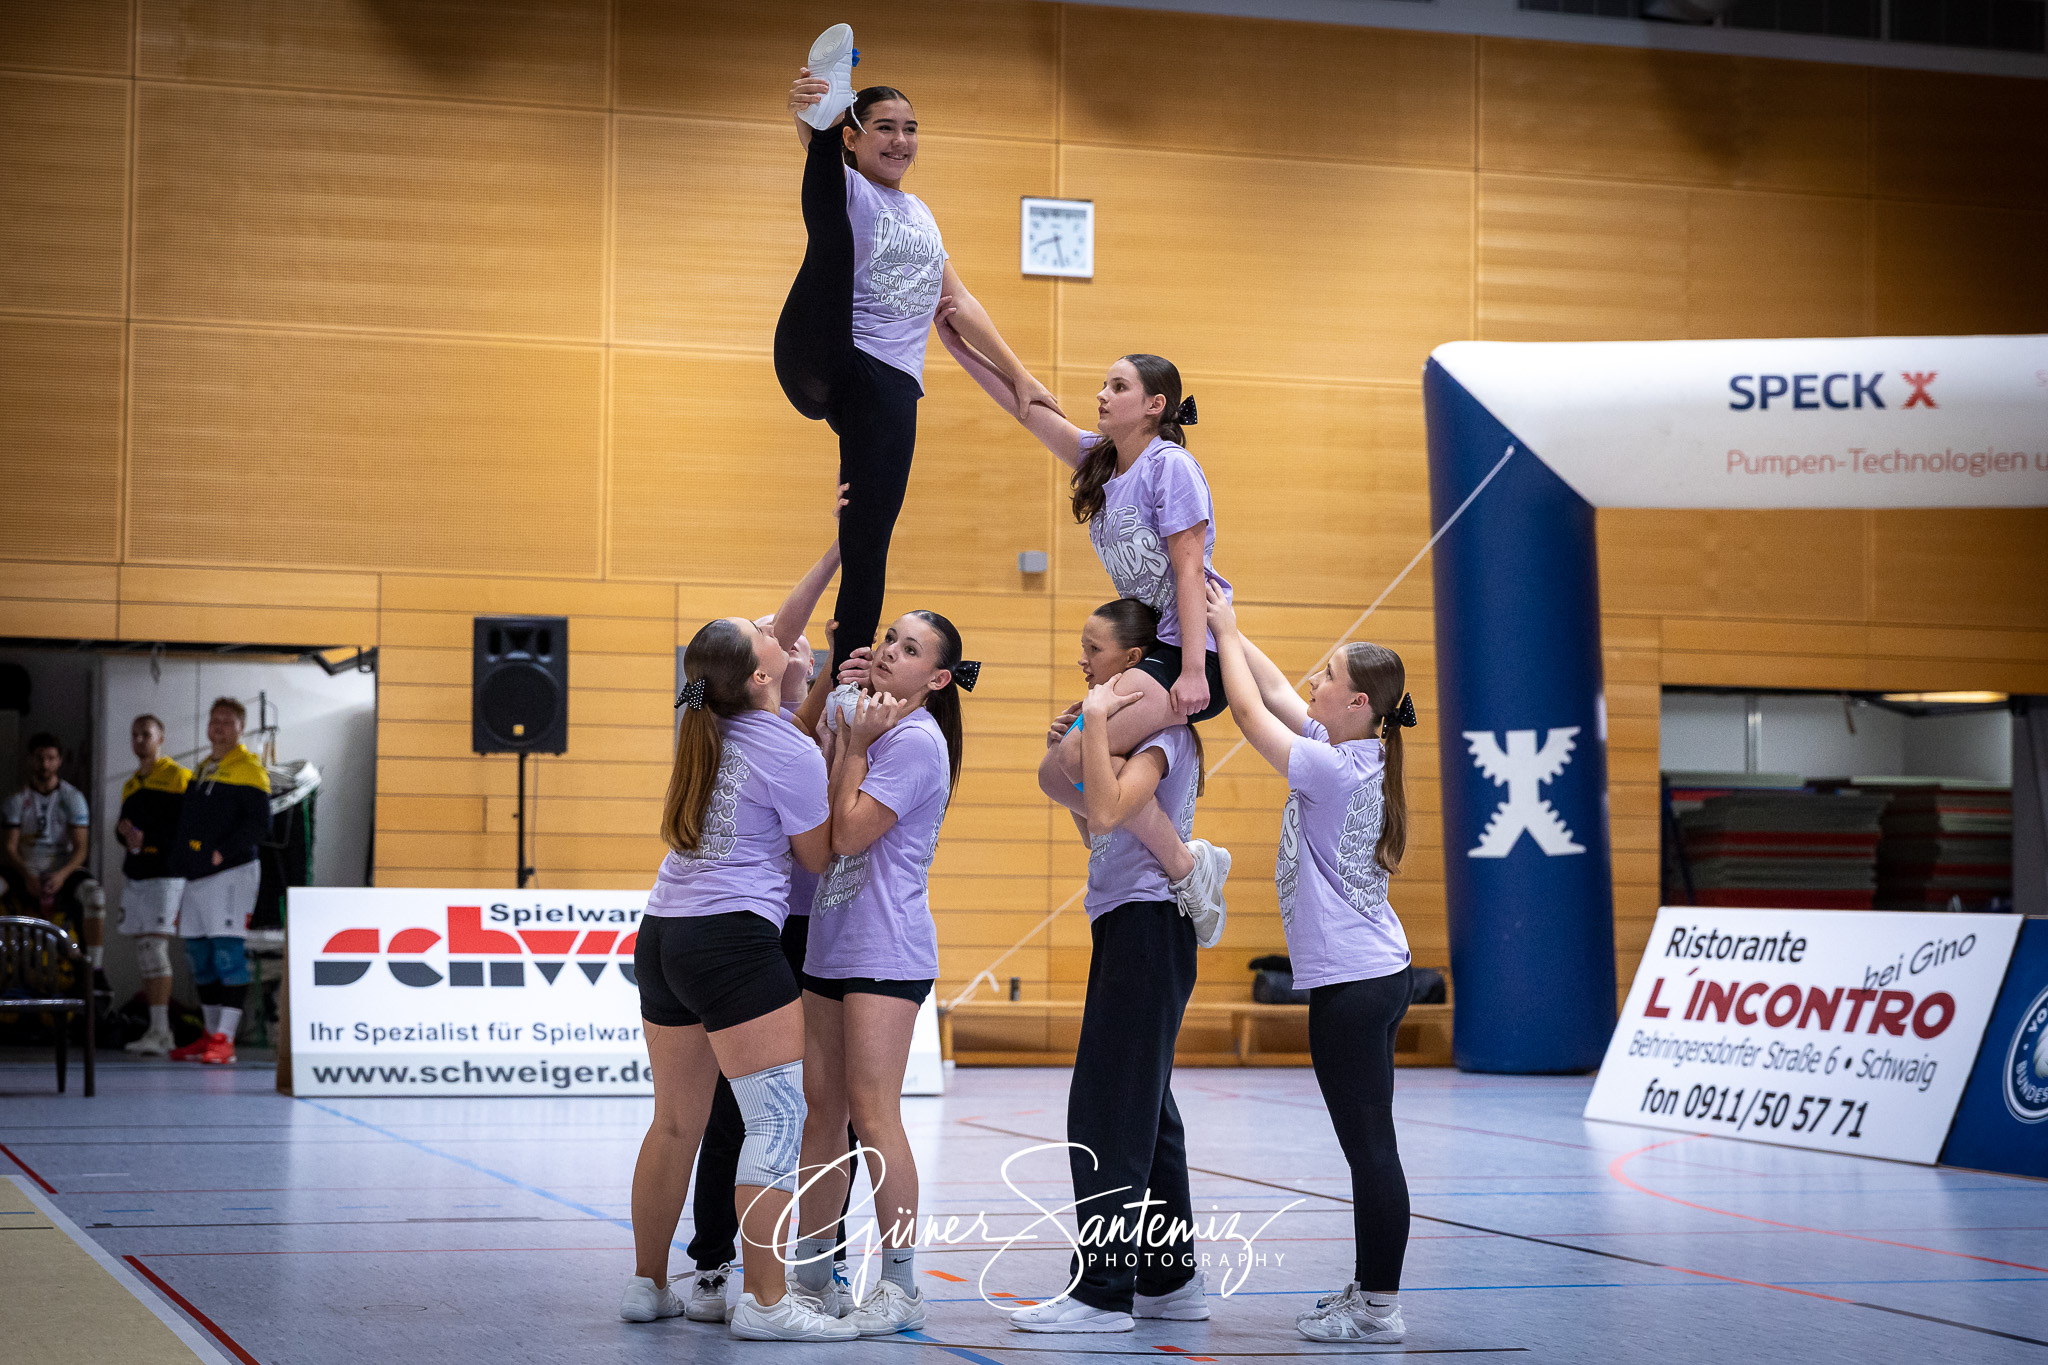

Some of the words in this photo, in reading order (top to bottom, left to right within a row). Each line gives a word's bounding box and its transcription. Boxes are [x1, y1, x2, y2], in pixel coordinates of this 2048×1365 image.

[1728, 371, 1887, 411] SPECK
[1727, 447, 2029, 478] Pumpen-Technologien
[490, 903, 641, 926] Spielwar
[1665, 925, 1806, 963] Ristorante
[1862, 953, 1904, 992] bei
[1909, 933, 1977, 975] Gino
[310, 1022, 344, 1041] Ihr
[354, 1022, 479, 1045] Spezialist
[488, 1022, 523, 1041] für
[533, 1022, 645, 1045] Spielwar
[313, 1061, 653, 1088] www.schweiger.de
[1628, 1029, 1761, 1067] Behringersdorfer
[1763, 1040, 1821, 1074] Straße
[1824, 1045, 1842, 1075] 6
[1856, 1047, 1938, 1092] Schwaig
[1640, 1078, 1679, 1115] fon
[1684, 1083, 1790, 1131] 0911/50
[1792, 1095, 1831, 1133] 57
[1832, 1100, 1868, 1138] 71
